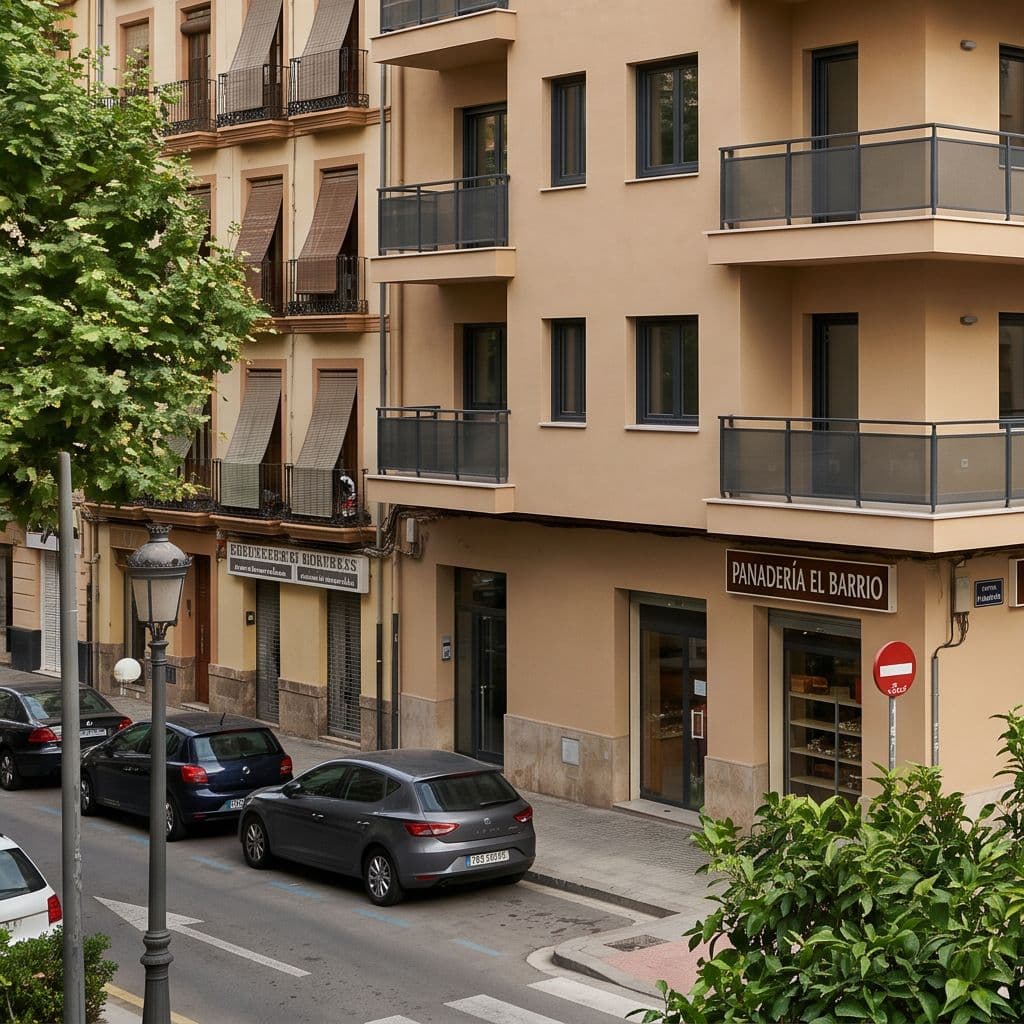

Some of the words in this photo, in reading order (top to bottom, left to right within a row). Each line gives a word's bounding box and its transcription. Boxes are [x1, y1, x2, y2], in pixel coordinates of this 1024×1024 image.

[732, 560, 806, 592] PANADERÍA
[810, 570, 825, 594] EL
[829, 572, 883, 601] BARRIO
